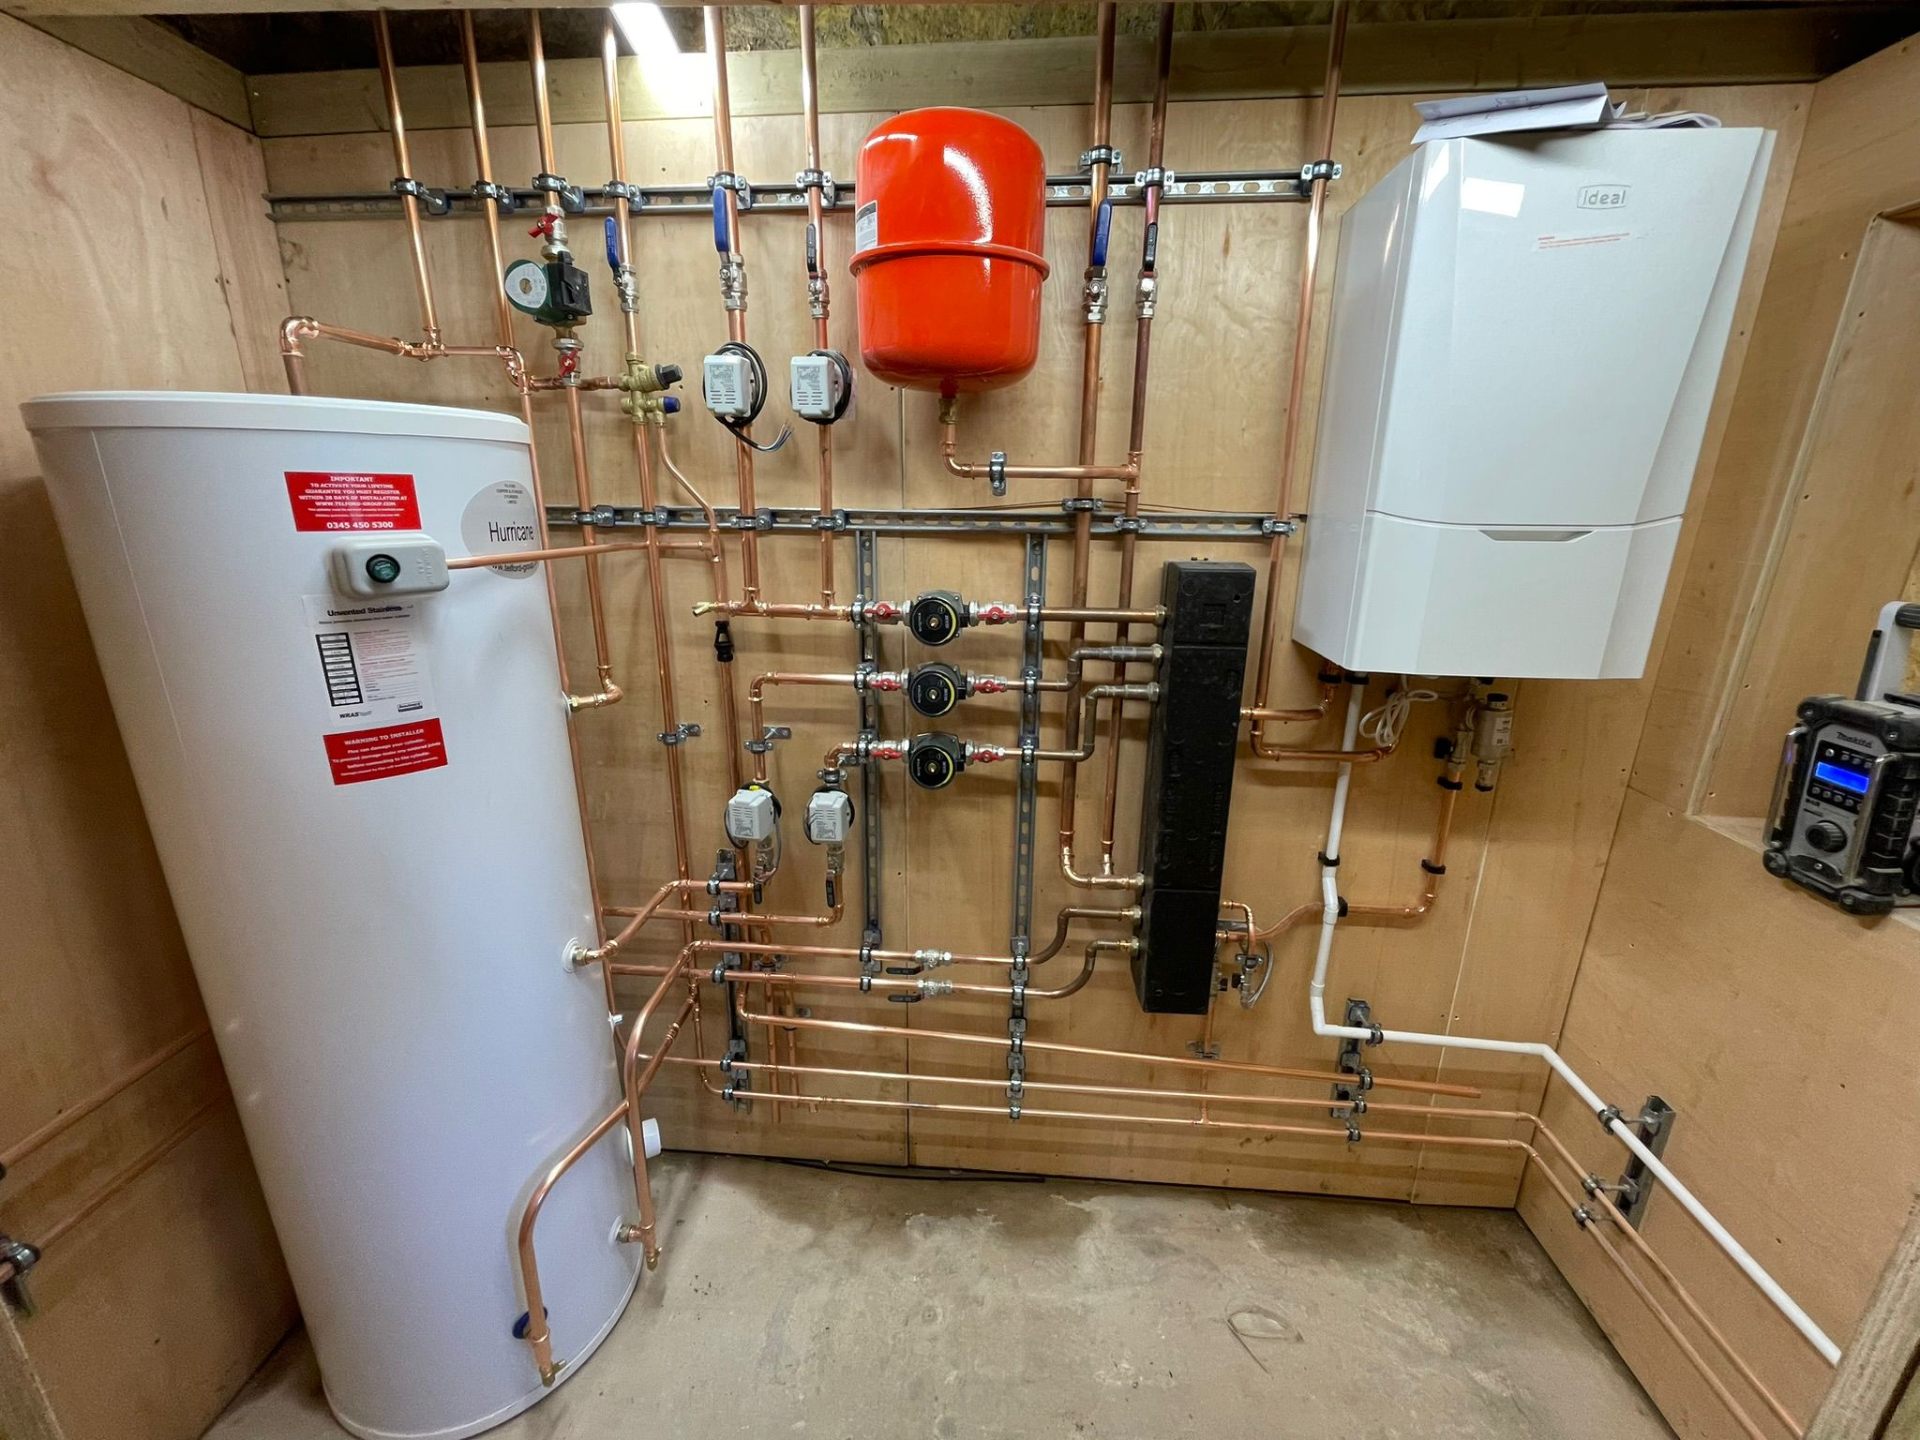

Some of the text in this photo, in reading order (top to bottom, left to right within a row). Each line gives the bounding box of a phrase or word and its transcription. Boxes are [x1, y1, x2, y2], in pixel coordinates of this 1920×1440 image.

[330, 475, 374, 483] IMPORTANT
[488, 521, 534, 542] Hurricane
[327, 605, 403, 617] Unvented Stainless
[344, 736, 379, 745] WARNING
[390, 728, 424, 739] INSTALLER
